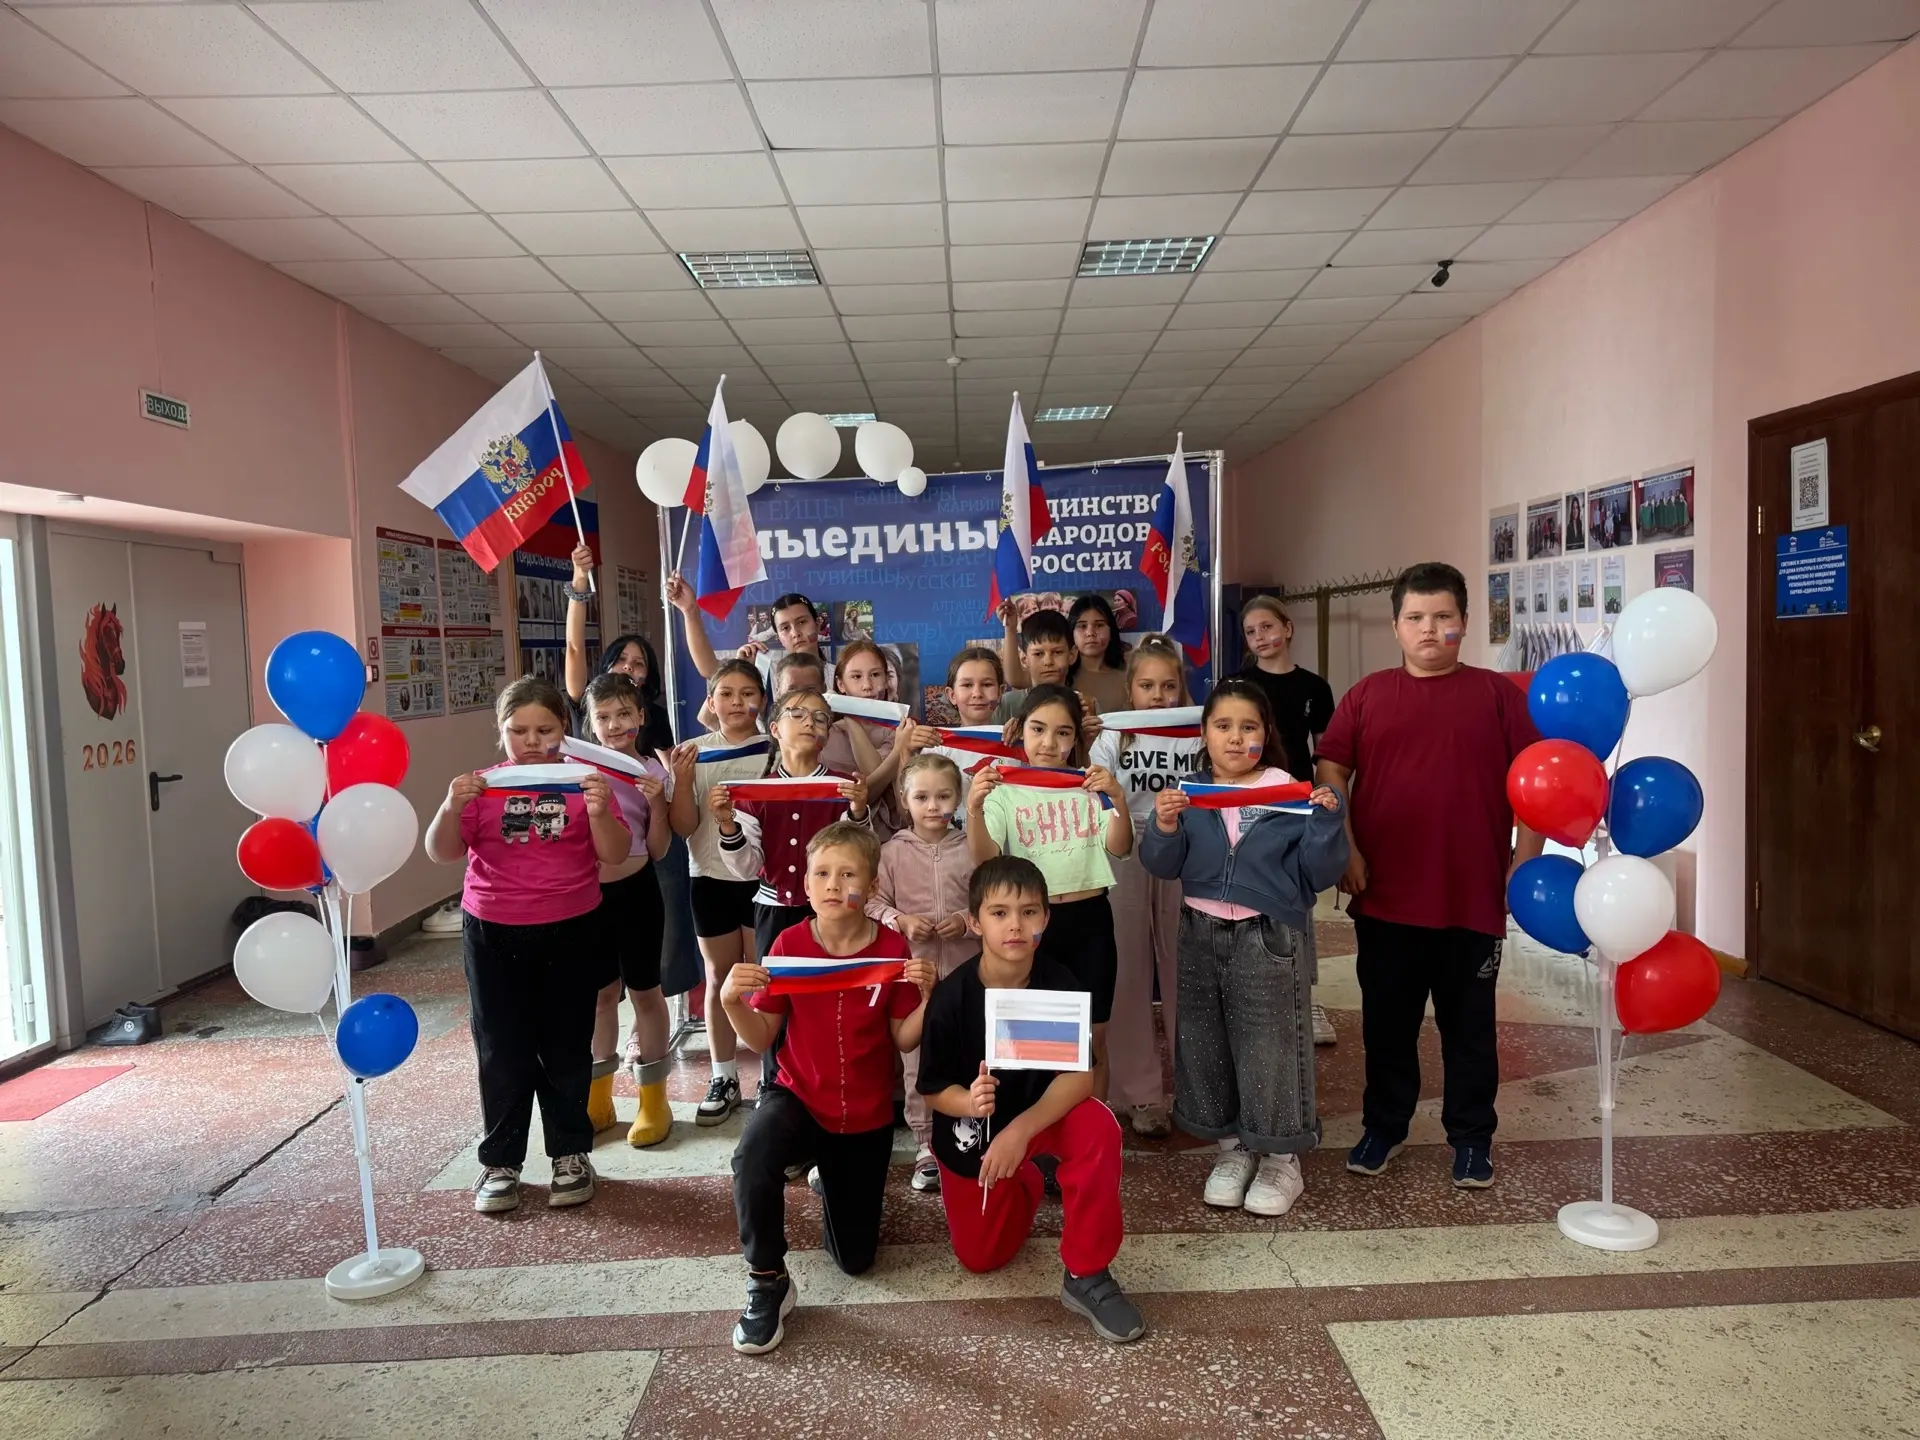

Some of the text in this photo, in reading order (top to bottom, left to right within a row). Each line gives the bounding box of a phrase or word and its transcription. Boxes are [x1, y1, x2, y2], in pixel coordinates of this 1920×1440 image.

[147, 397, 186, 422] ВЫХОД
[1034, 522, 1151, 549] АРОДОВ
[1031, 550, 1133, 574] РОССИИ
[82, 739, 137, 772] 2026
[1119, 750, 1168, 770] GIVE
[1131, 772, 1185, 793] MOR
[866, 983, 882, 1007] 7
